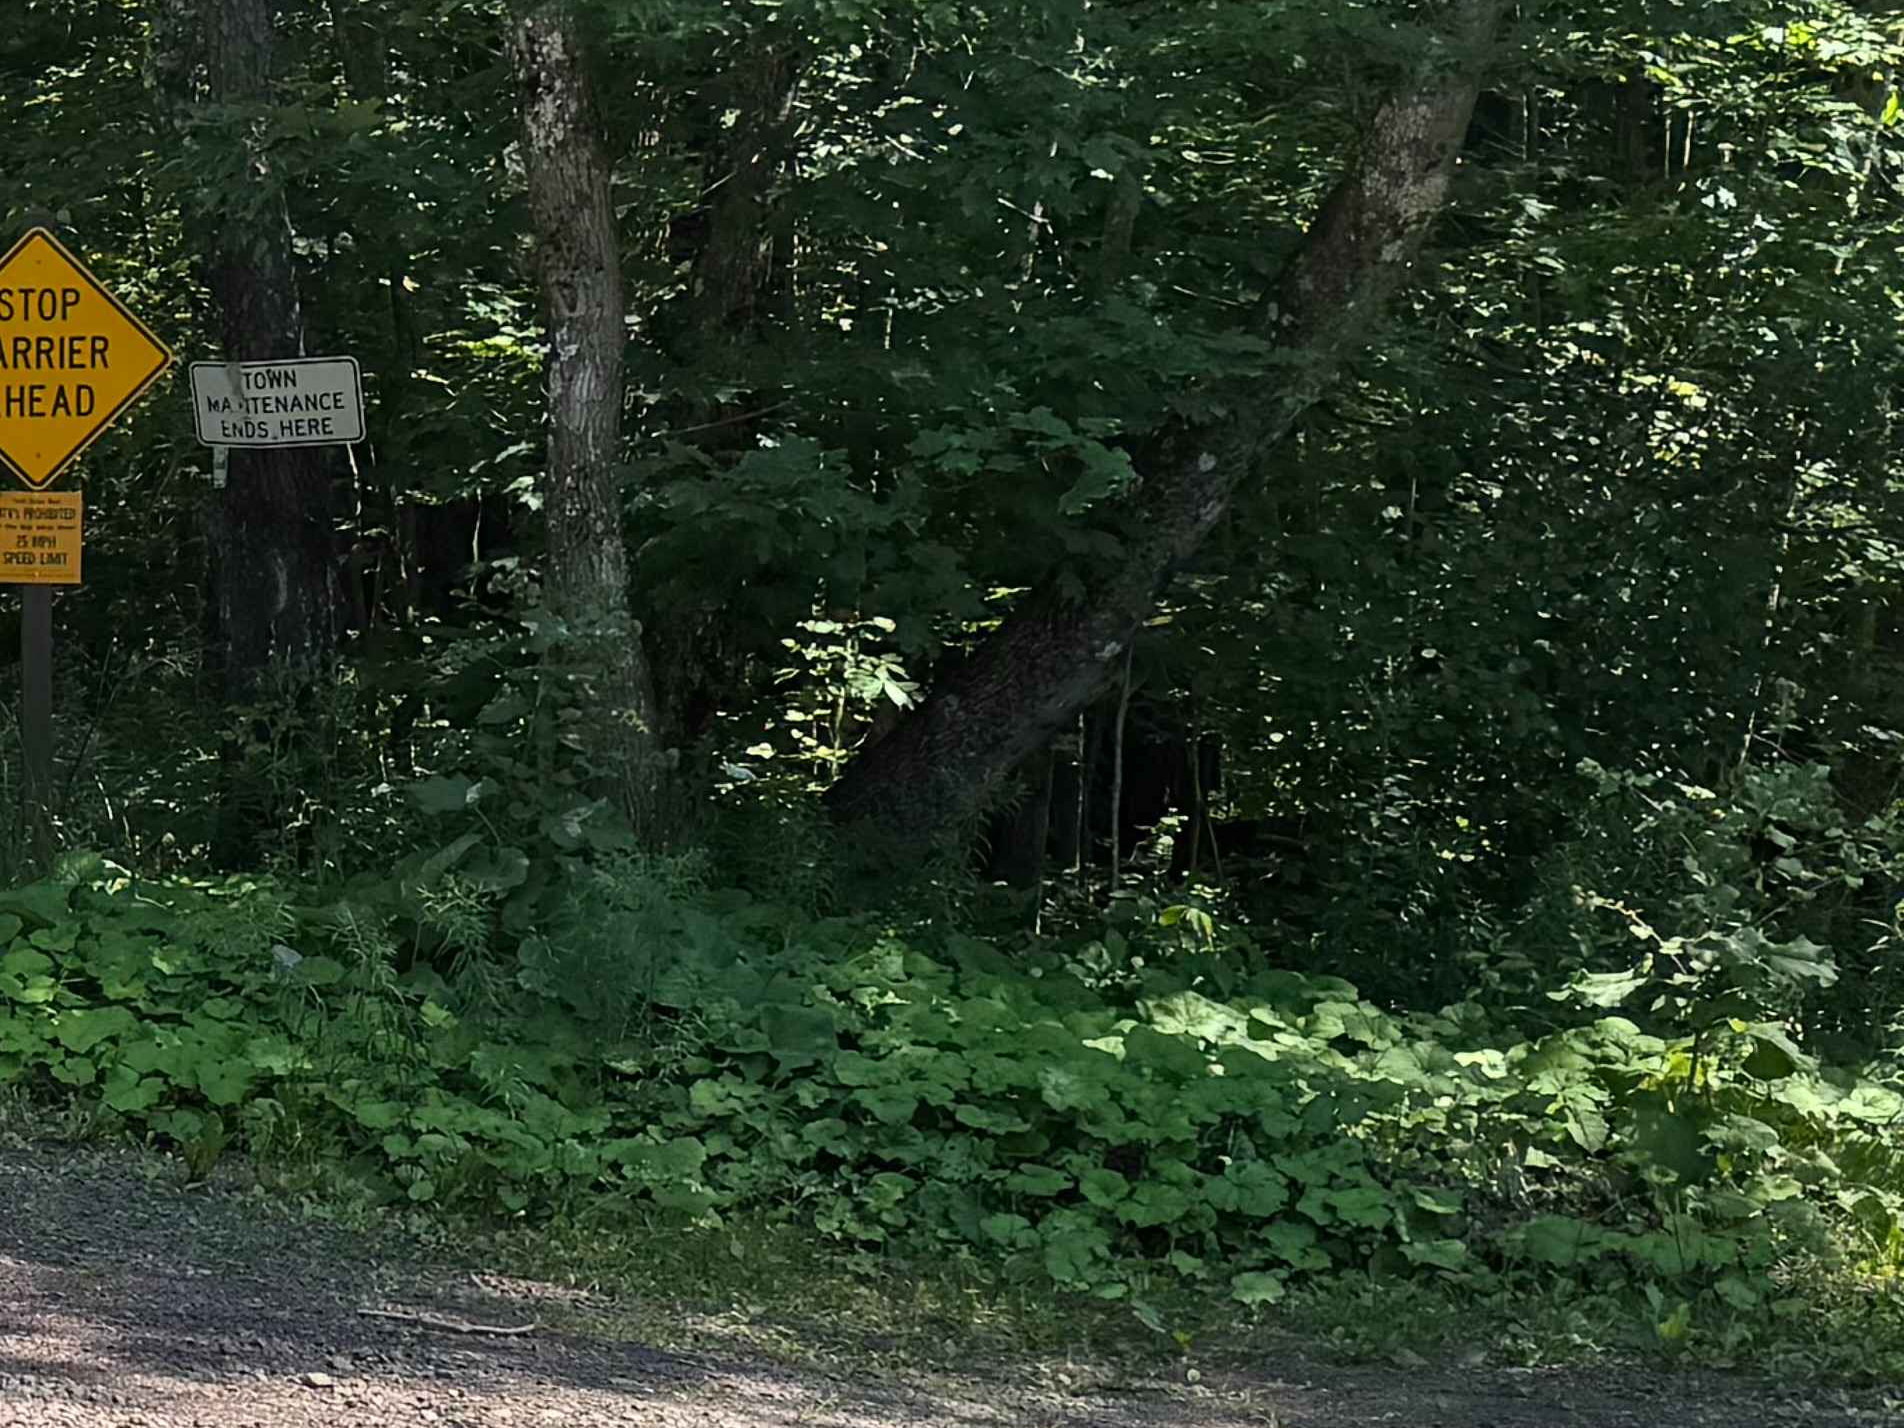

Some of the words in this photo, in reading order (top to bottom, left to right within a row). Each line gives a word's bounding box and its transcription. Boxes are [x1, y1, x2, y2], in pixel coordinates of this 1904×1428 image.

[243, 369, 297, 390] TOWN
[207, 392, 345, 414] MATENANCE
[221, 420, 269, 439] ENDS
[280, 417, 334, 437] HERE
[32, 535, 57, 549] MPH
[3, 551, 35, 565] SPEED
[39, 552, 68, 565] LIMIT
